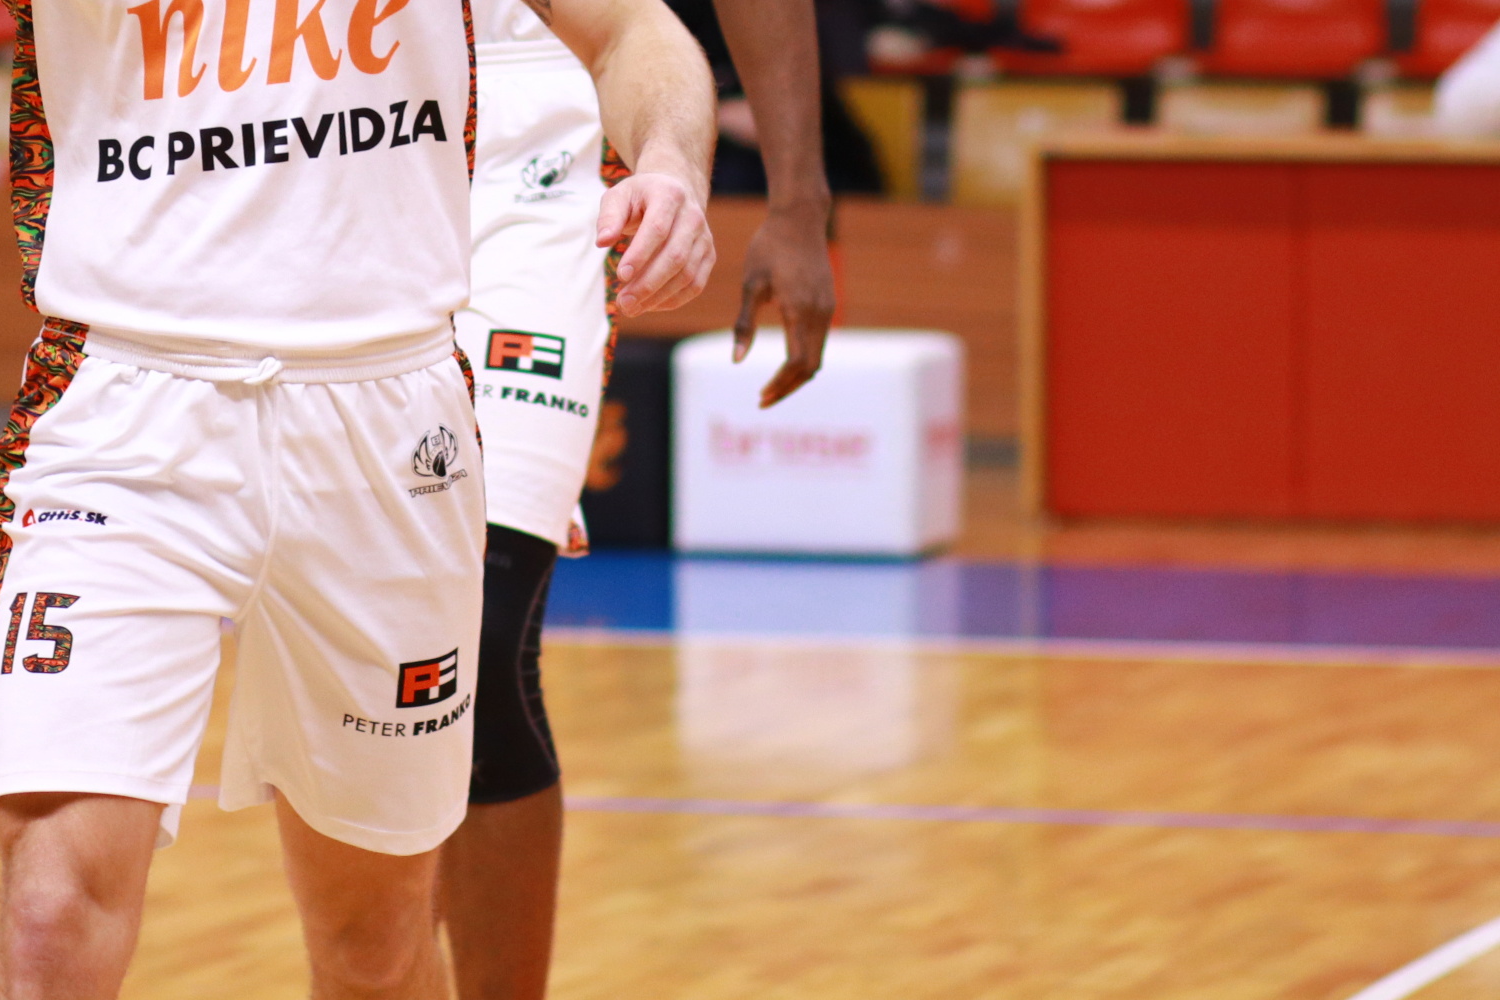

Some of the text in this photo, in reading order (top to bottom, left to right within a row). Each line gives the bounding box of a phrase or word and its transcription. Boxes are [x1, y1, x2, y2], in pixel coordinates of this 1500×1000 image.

[97, 100, 447, 182] BC PRIEVIDZA
[500, 386, 589, 418] FRANKO
[0, 592, 81, 675] 15
[342, 693, 471, 737] PETER FRANKO
